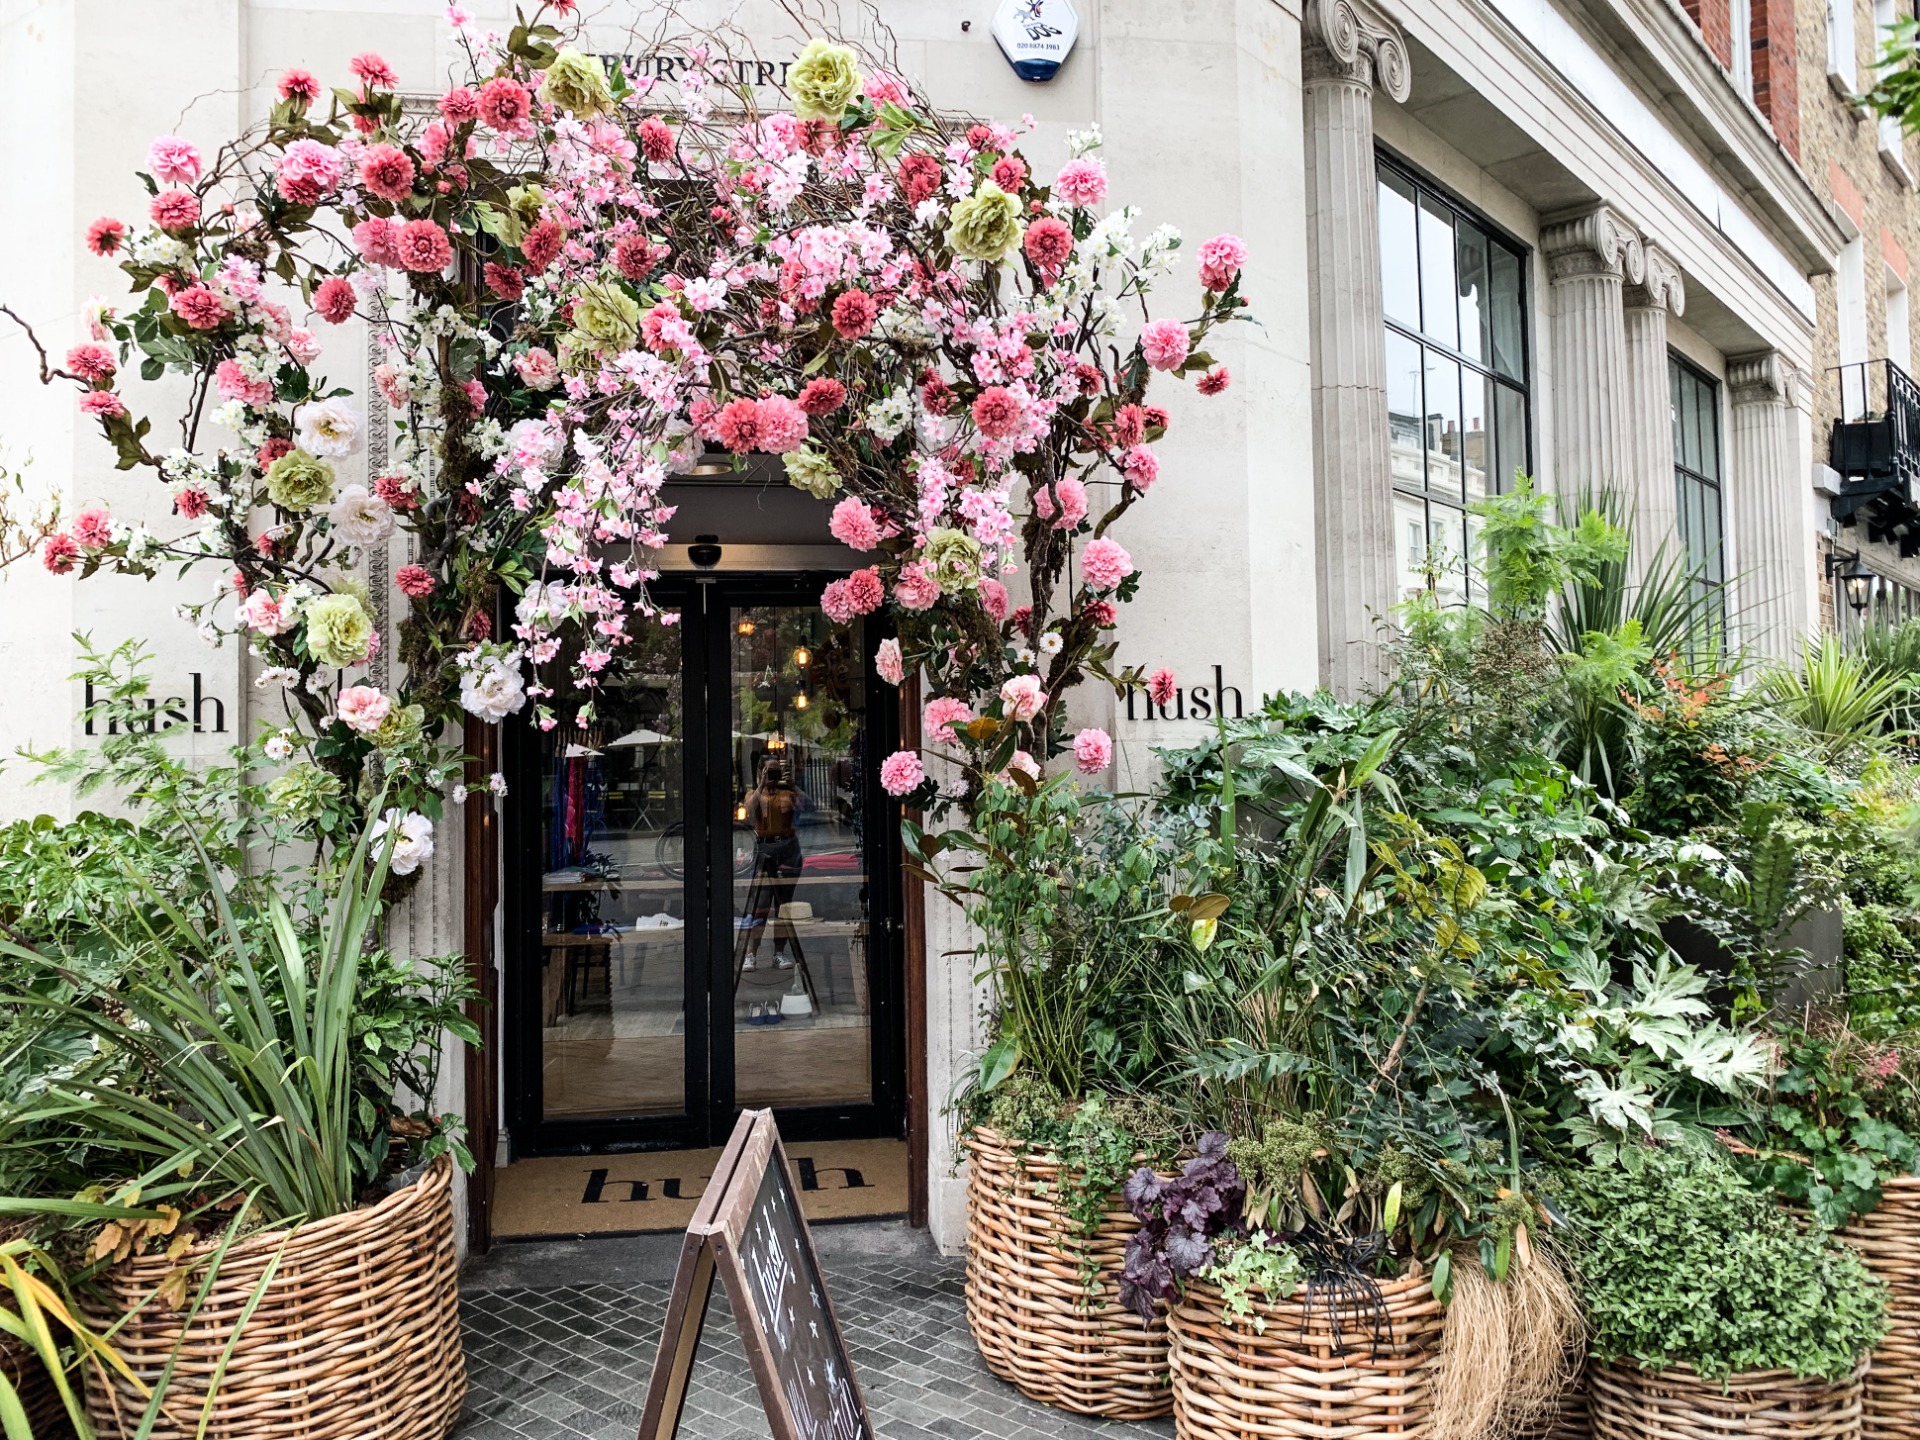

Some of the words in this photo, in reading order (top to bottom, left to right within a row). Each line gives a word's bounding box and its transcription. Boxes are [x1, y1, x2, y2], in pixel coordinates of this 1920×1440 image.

[85, 672, 229, 736] hush
[1122, 664, 1245, 721] hush
[581, 1157, 875, 1204] huh
[752, 1204, 785, 1323] hush
